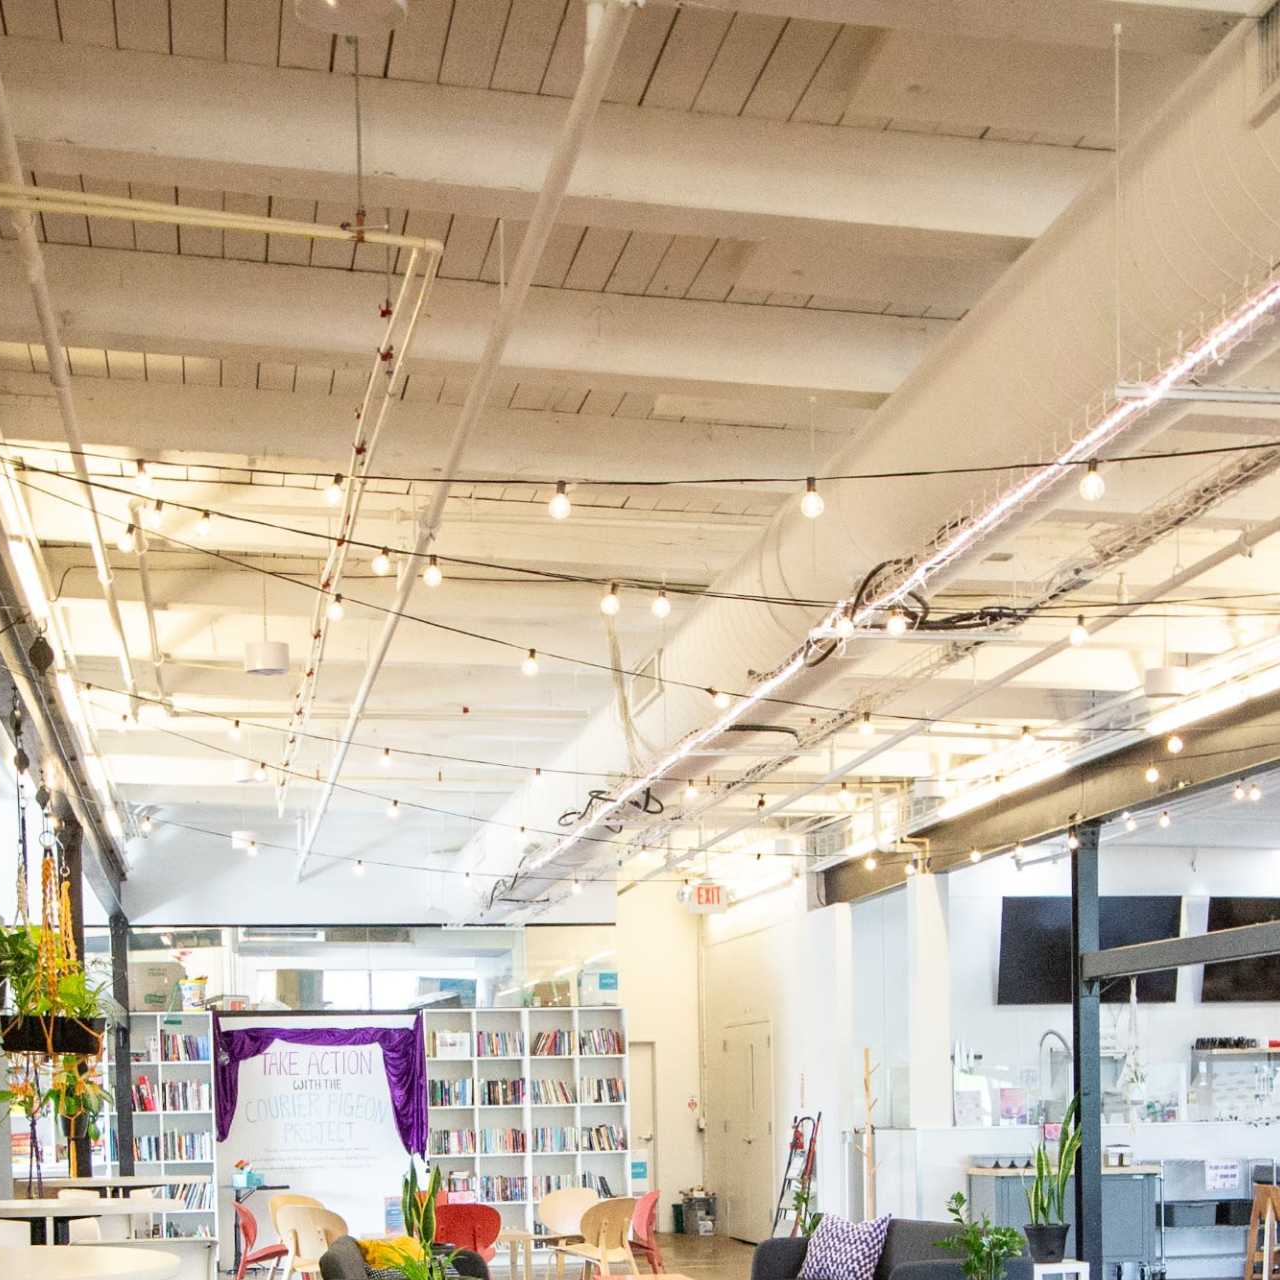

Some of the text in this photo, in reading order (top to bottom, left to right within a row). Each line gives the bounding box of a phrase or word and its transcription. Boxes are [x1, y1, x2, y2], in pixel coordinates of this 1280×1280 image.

[697, 886, 720, 905] EXIT
[262, 1051, 373, 1076] TAKE ACTION
[292, 1079, 343, 1091] WITH THE
[245, 1093, 389, 1124] COURIER PIGEON
